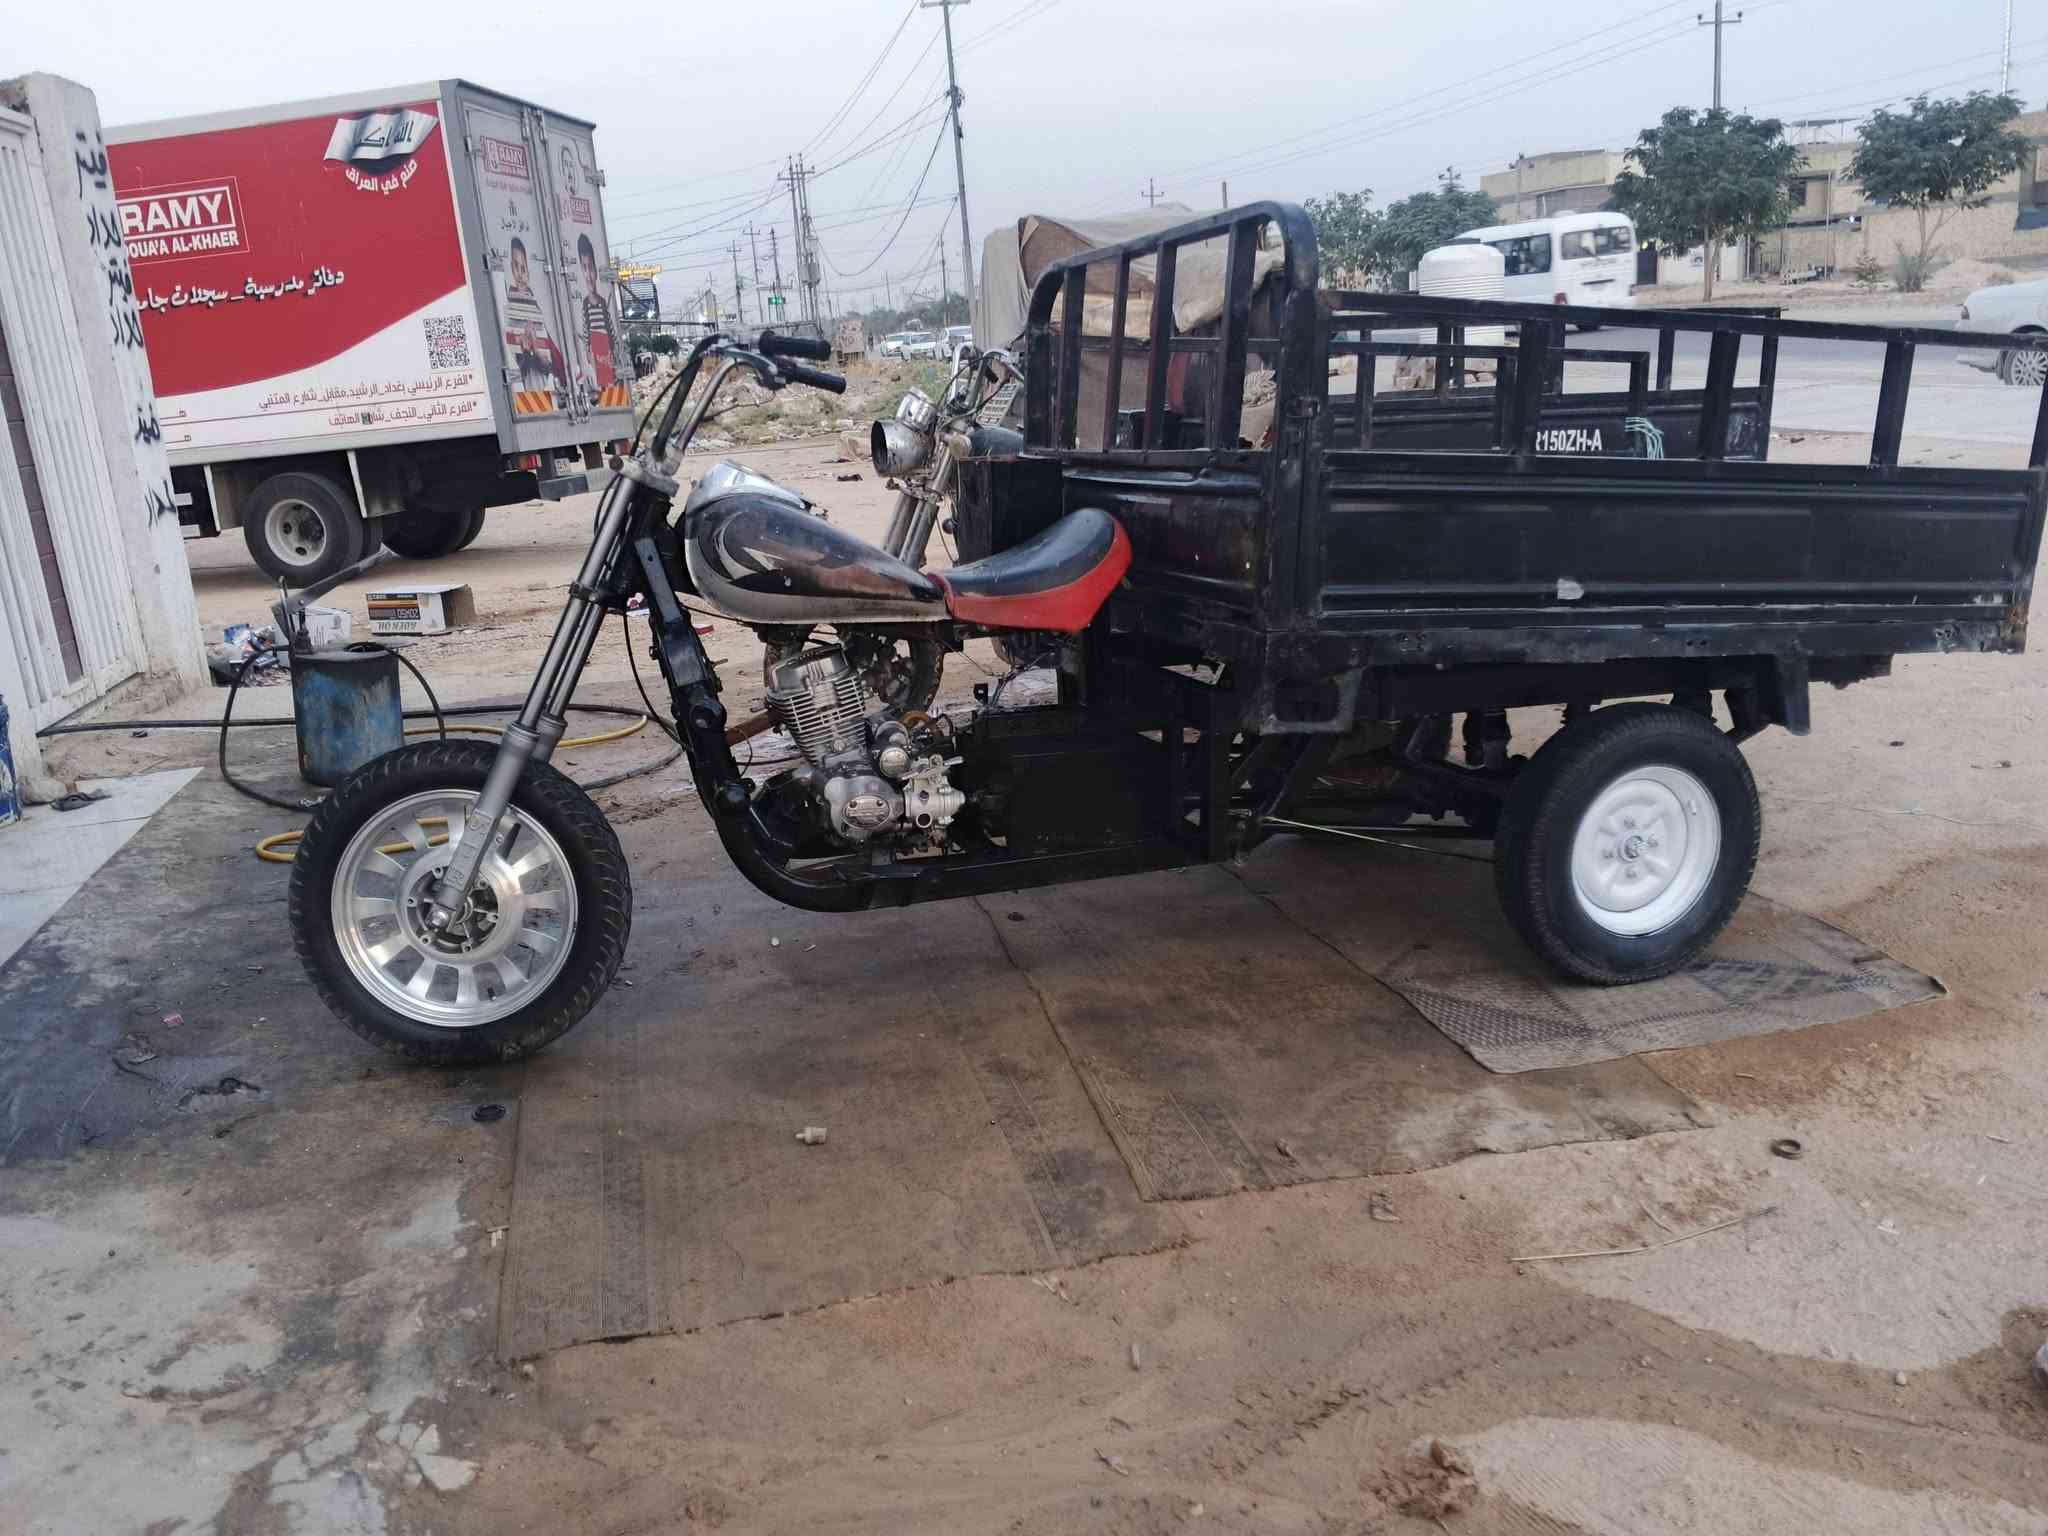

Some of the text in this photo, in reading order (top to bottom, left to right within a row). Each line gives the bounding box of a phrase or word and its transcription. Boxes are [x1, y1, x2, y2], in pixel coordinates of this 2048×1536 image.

[345, 159, 418, 195] صنع في العراق
[119, 193, 223, 235] RAMY
[128, 230, 240, 258] OUA'A AL-KHAER
[307, 265, 344, 296] دفاتر
[171, 285, 229, 308] سجلات
